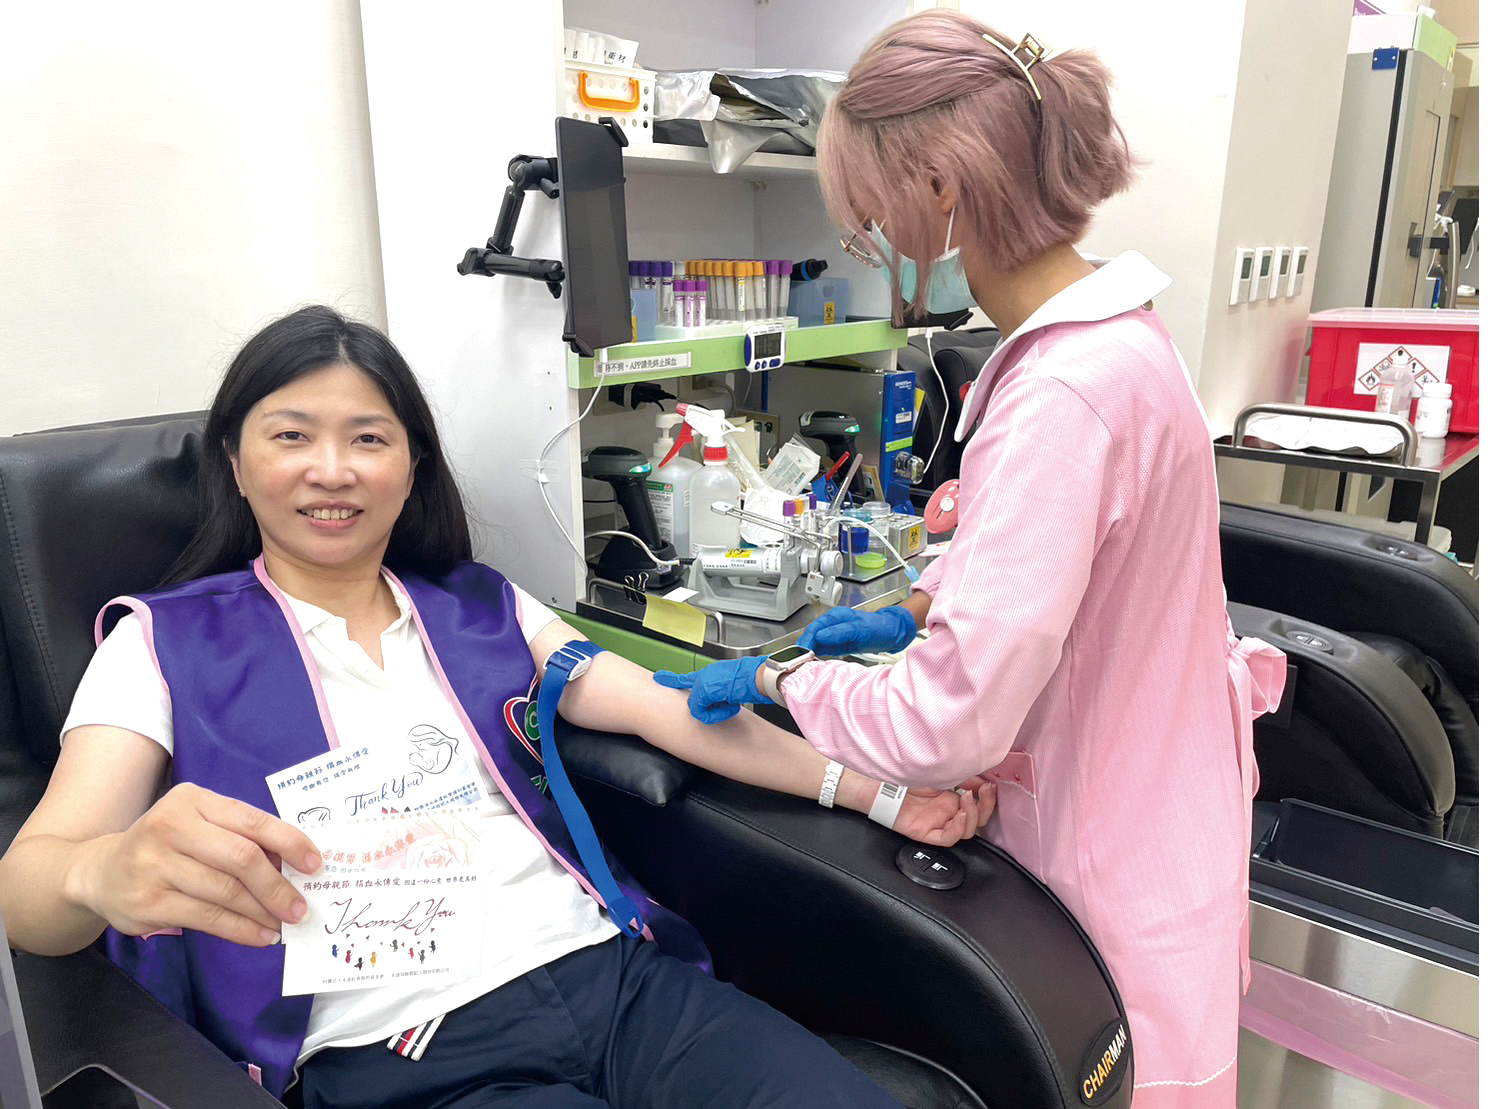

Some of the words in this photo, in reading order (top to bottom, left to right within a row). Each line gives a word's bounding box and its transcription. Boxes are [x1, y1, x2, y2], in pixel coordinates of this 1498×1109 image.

[344, 782, 394, 817] Thank
[389, 771, 424, 799] You
[303, 880, 350, 892] 預約母親節
[355, 877, 401, 889] 捐血永傳愛
[324, 897, 420, 935] Thank
[413, 896, 456, 936] You
[1083, 1023, 1127, 1099] CHAIRMAN
